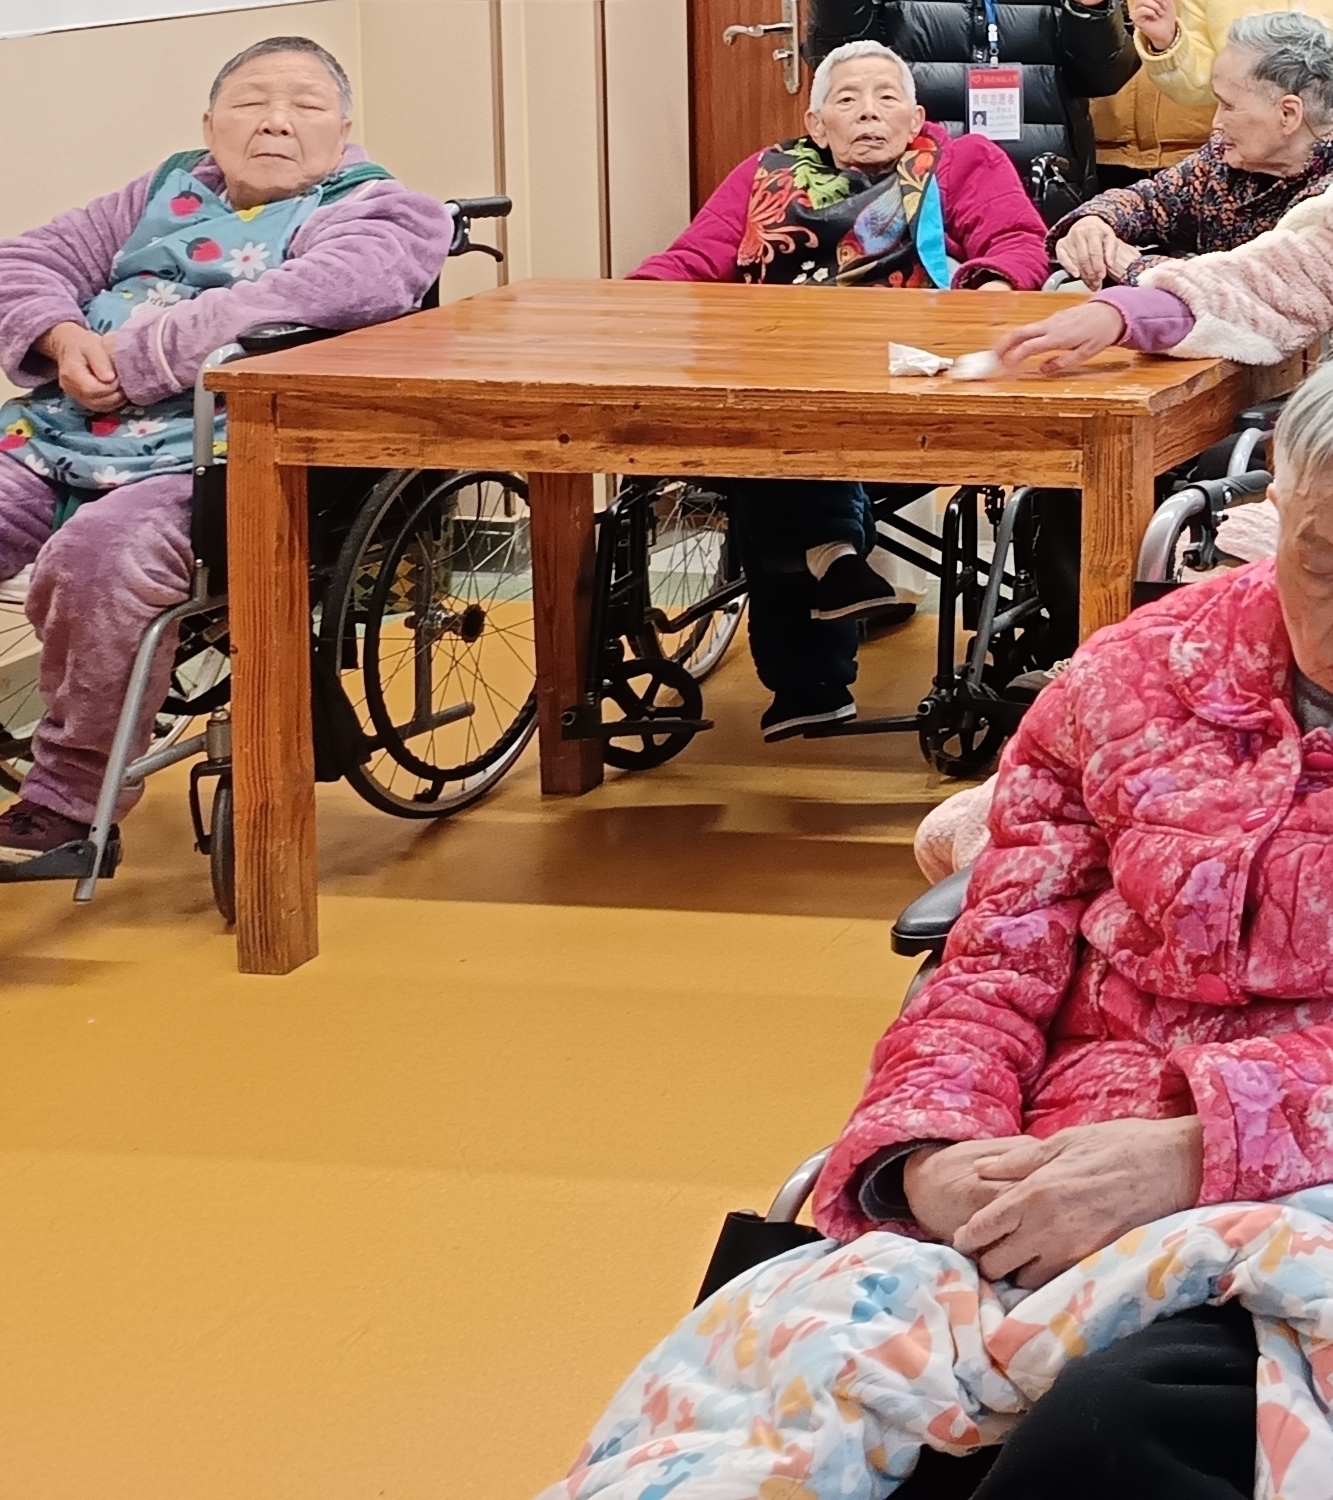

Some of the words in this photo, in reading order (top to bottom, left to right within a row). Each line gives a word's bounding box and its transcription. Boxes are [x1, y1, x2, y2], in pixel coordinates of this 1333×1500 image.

[973, 93, 1015, 106] 青年志愿者
